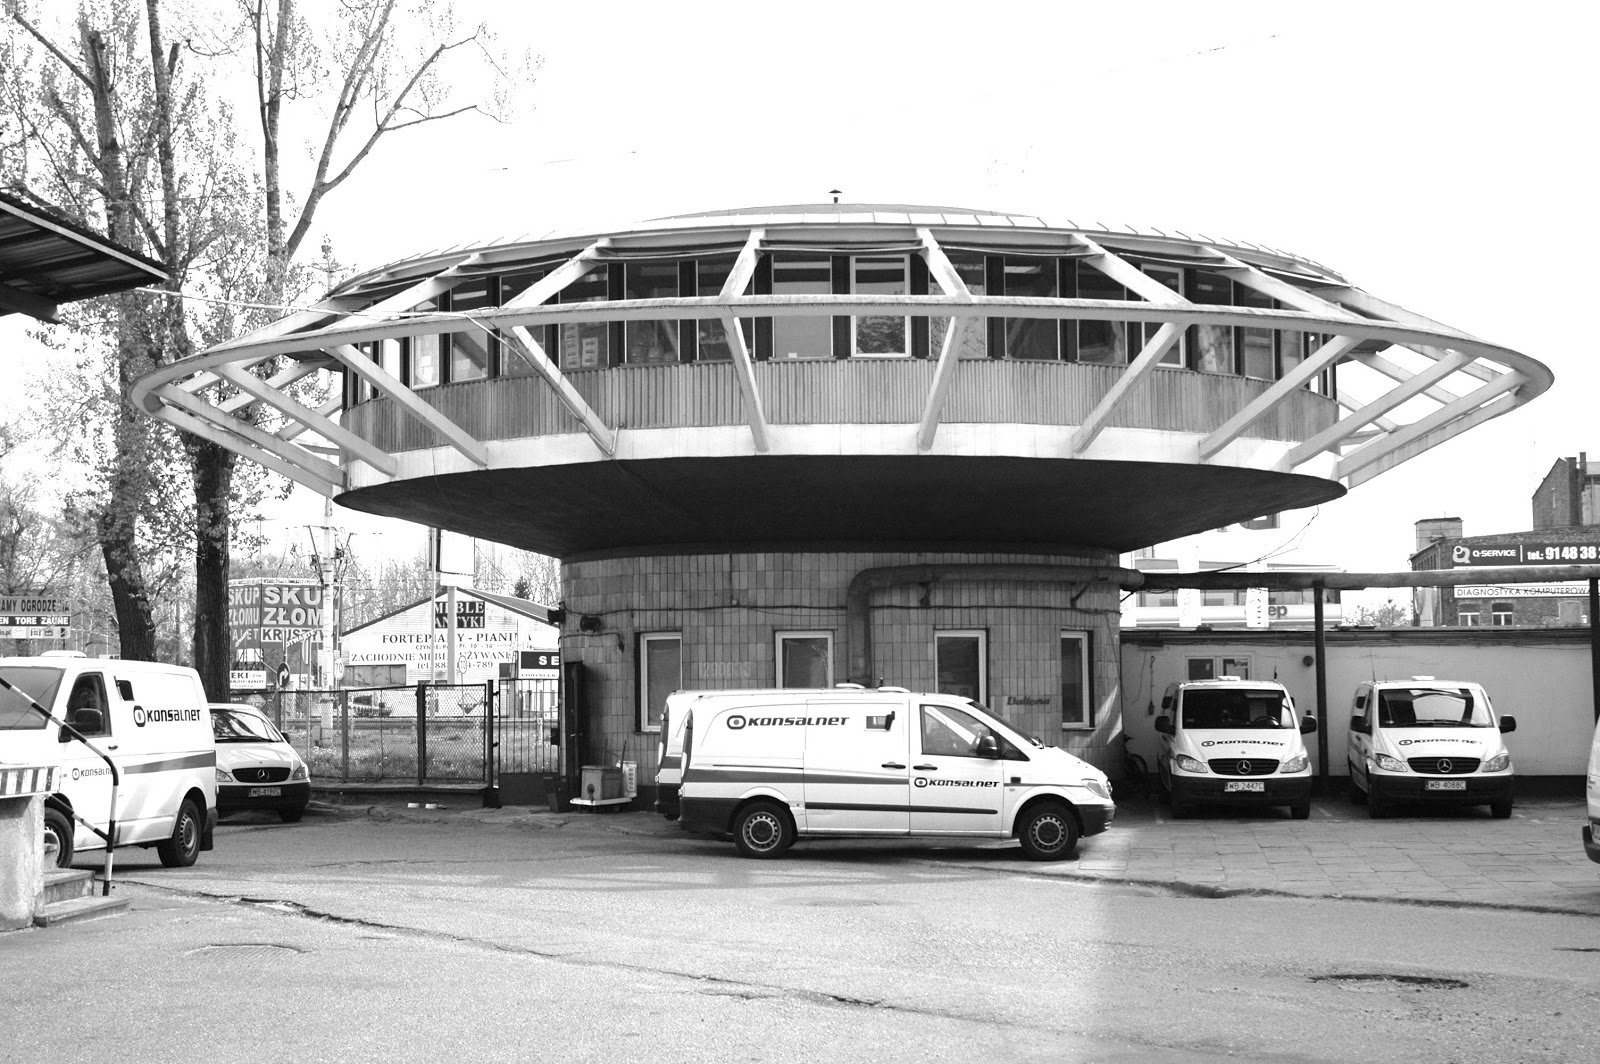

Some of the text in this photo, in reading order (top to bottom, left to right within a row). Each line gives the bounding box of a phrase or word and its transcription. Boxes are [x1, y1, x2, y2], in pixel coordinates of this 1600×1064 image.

[228, 587, 260, 606] SKUP
[1457, 588, 1520, 597] DIAGNOSTYKA
[15, 617, 37, 625] TORE
[351, 653, 415, 662] ZACHODNIE
